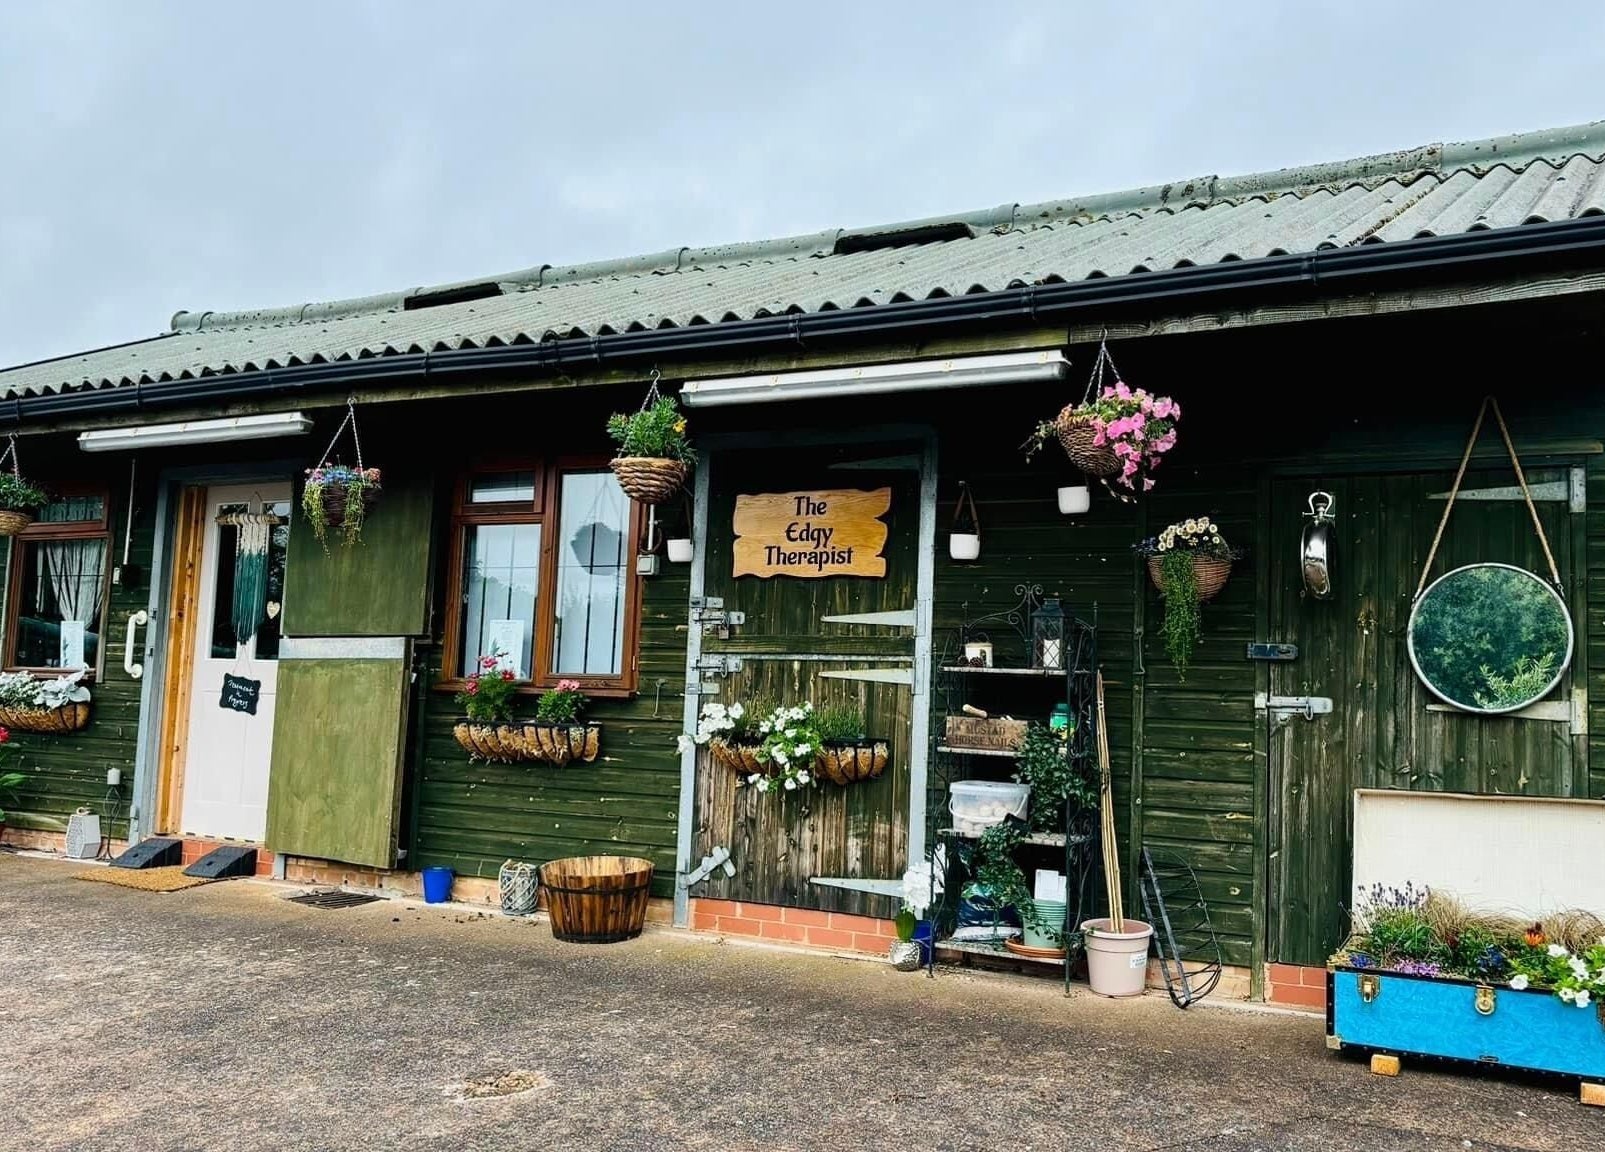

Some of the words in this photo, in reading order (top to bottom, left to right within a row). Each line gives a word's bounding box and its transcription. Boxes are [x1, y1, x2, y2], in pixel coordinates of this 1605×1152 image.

[794, 495, 827, 516] The
[785, 522, 833, 549] Edgy
[765, 546, 853, 572] Therapist
